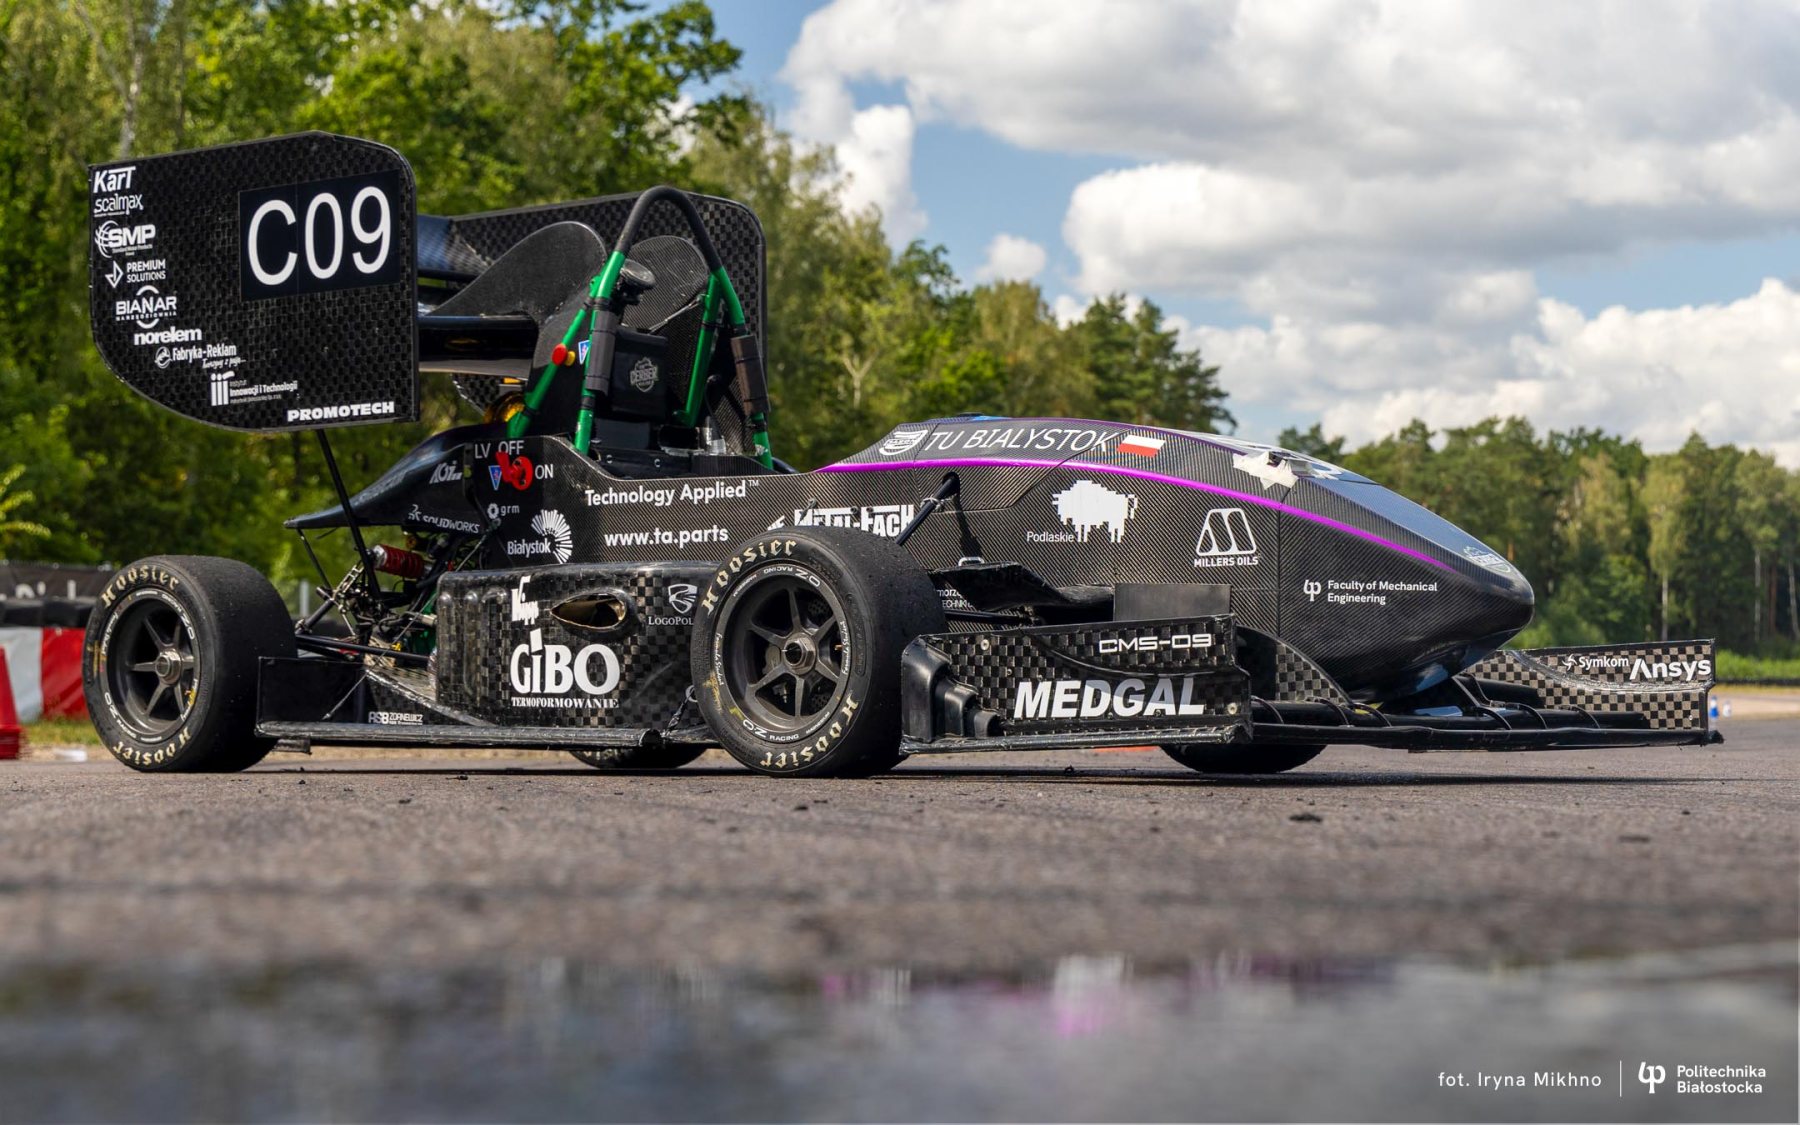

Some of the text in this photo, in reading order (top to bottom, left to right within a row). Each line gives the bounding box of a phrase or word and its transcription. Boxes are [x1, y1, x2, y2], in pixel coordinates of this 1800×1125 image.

[94, 193, 144, 215] scalmax
[108, 224, 156, 248] SMP
[247, 186, 392, 286] C09
[126, 259, 166, 273] PREMIUM
[126, 271, 166, 283] SOLUTIONS
[116, 296, 177, 315] BIANAR
[134, 326, 202, 345] norelem
[172, 343, 237, 363] Fabryka-Reklam
[287, 401, 394, 422] PROMOTECH
[474, 440, 524, 459] LV OFF
[925, 428, 1119, 452] TU BIALYSTOK
[534, 464, 553, 479] ON
[585, 485, 674, 506] Technology
[500, 505, 520, 517] grm
[604, 525, 729, 548] www.ta.parts
[1026, 531, 1074, 543] Podlaskie
[507, 539, 551, 558] Białystok
[1193, 556, 1259, 567] MILLERS OILS
[1328, 580, 1438, 592] Faculty of Mechanical
[1328, 593, 1386, 605] Engineering
[1099, 633, 1212, 654] CMS-09
[1579, 655, 1629, 669] Symkom
[1629, 658, 1711, 681] Ansys
[511, 697, 619, 709] TERMOFORMOWANIE
[1013, 678, 1205, 719] MEDGAL
